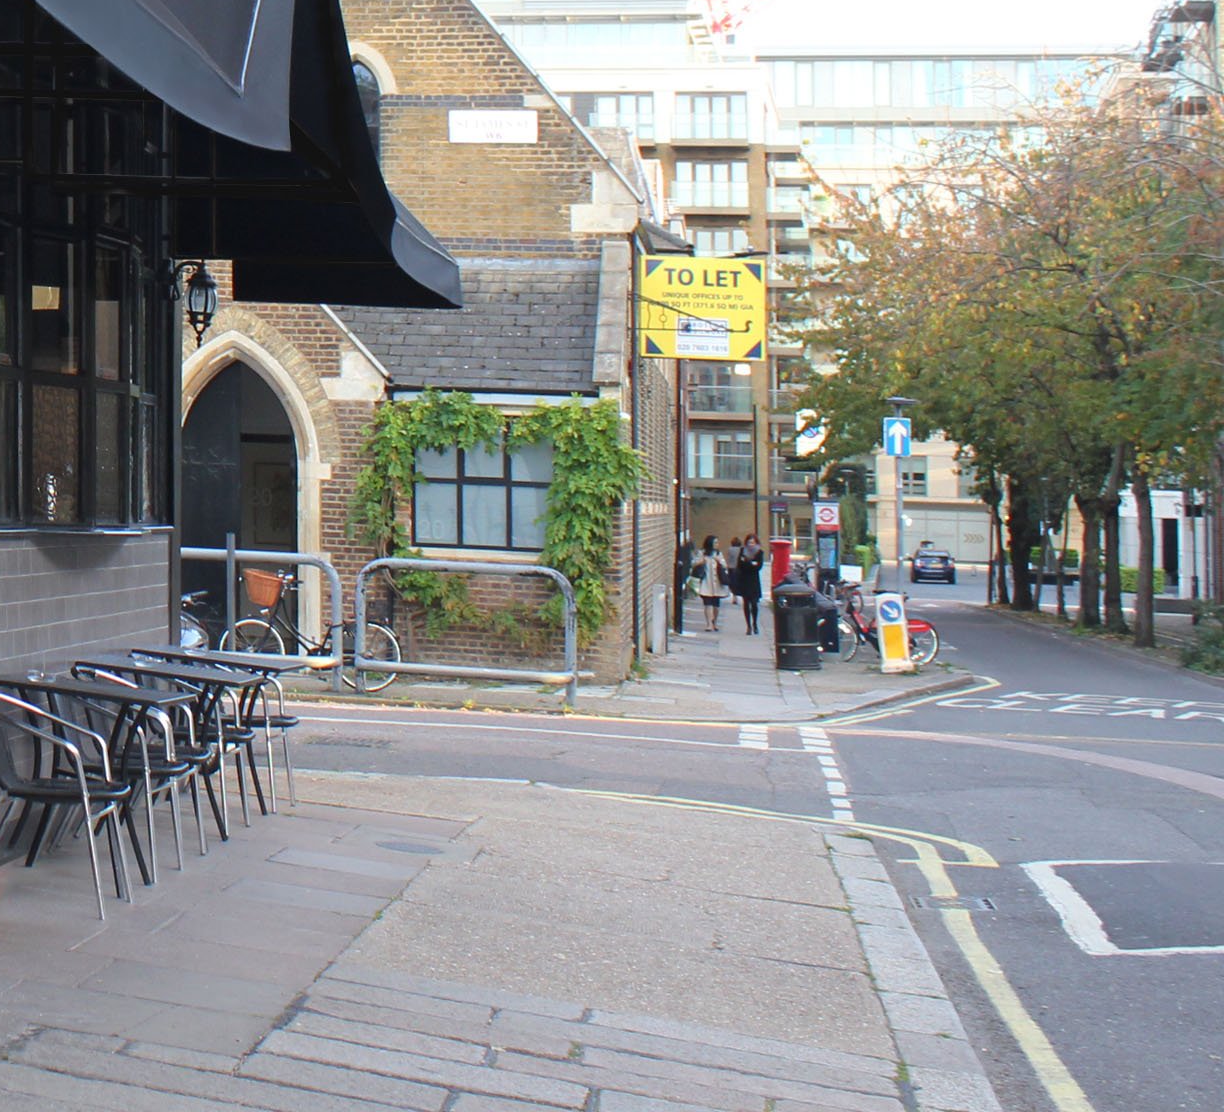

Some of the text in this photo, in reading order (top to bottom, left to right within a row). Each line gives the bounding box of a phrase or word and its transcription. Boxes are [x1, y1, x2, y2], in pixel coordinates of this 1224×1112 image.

[664, 268, 742, 288] TO LET
[662, 291, 690, 299] UNIQUE
[691, 292, 721, 300] OFFICES
[935, 697, 1224, 722] CLEAR
